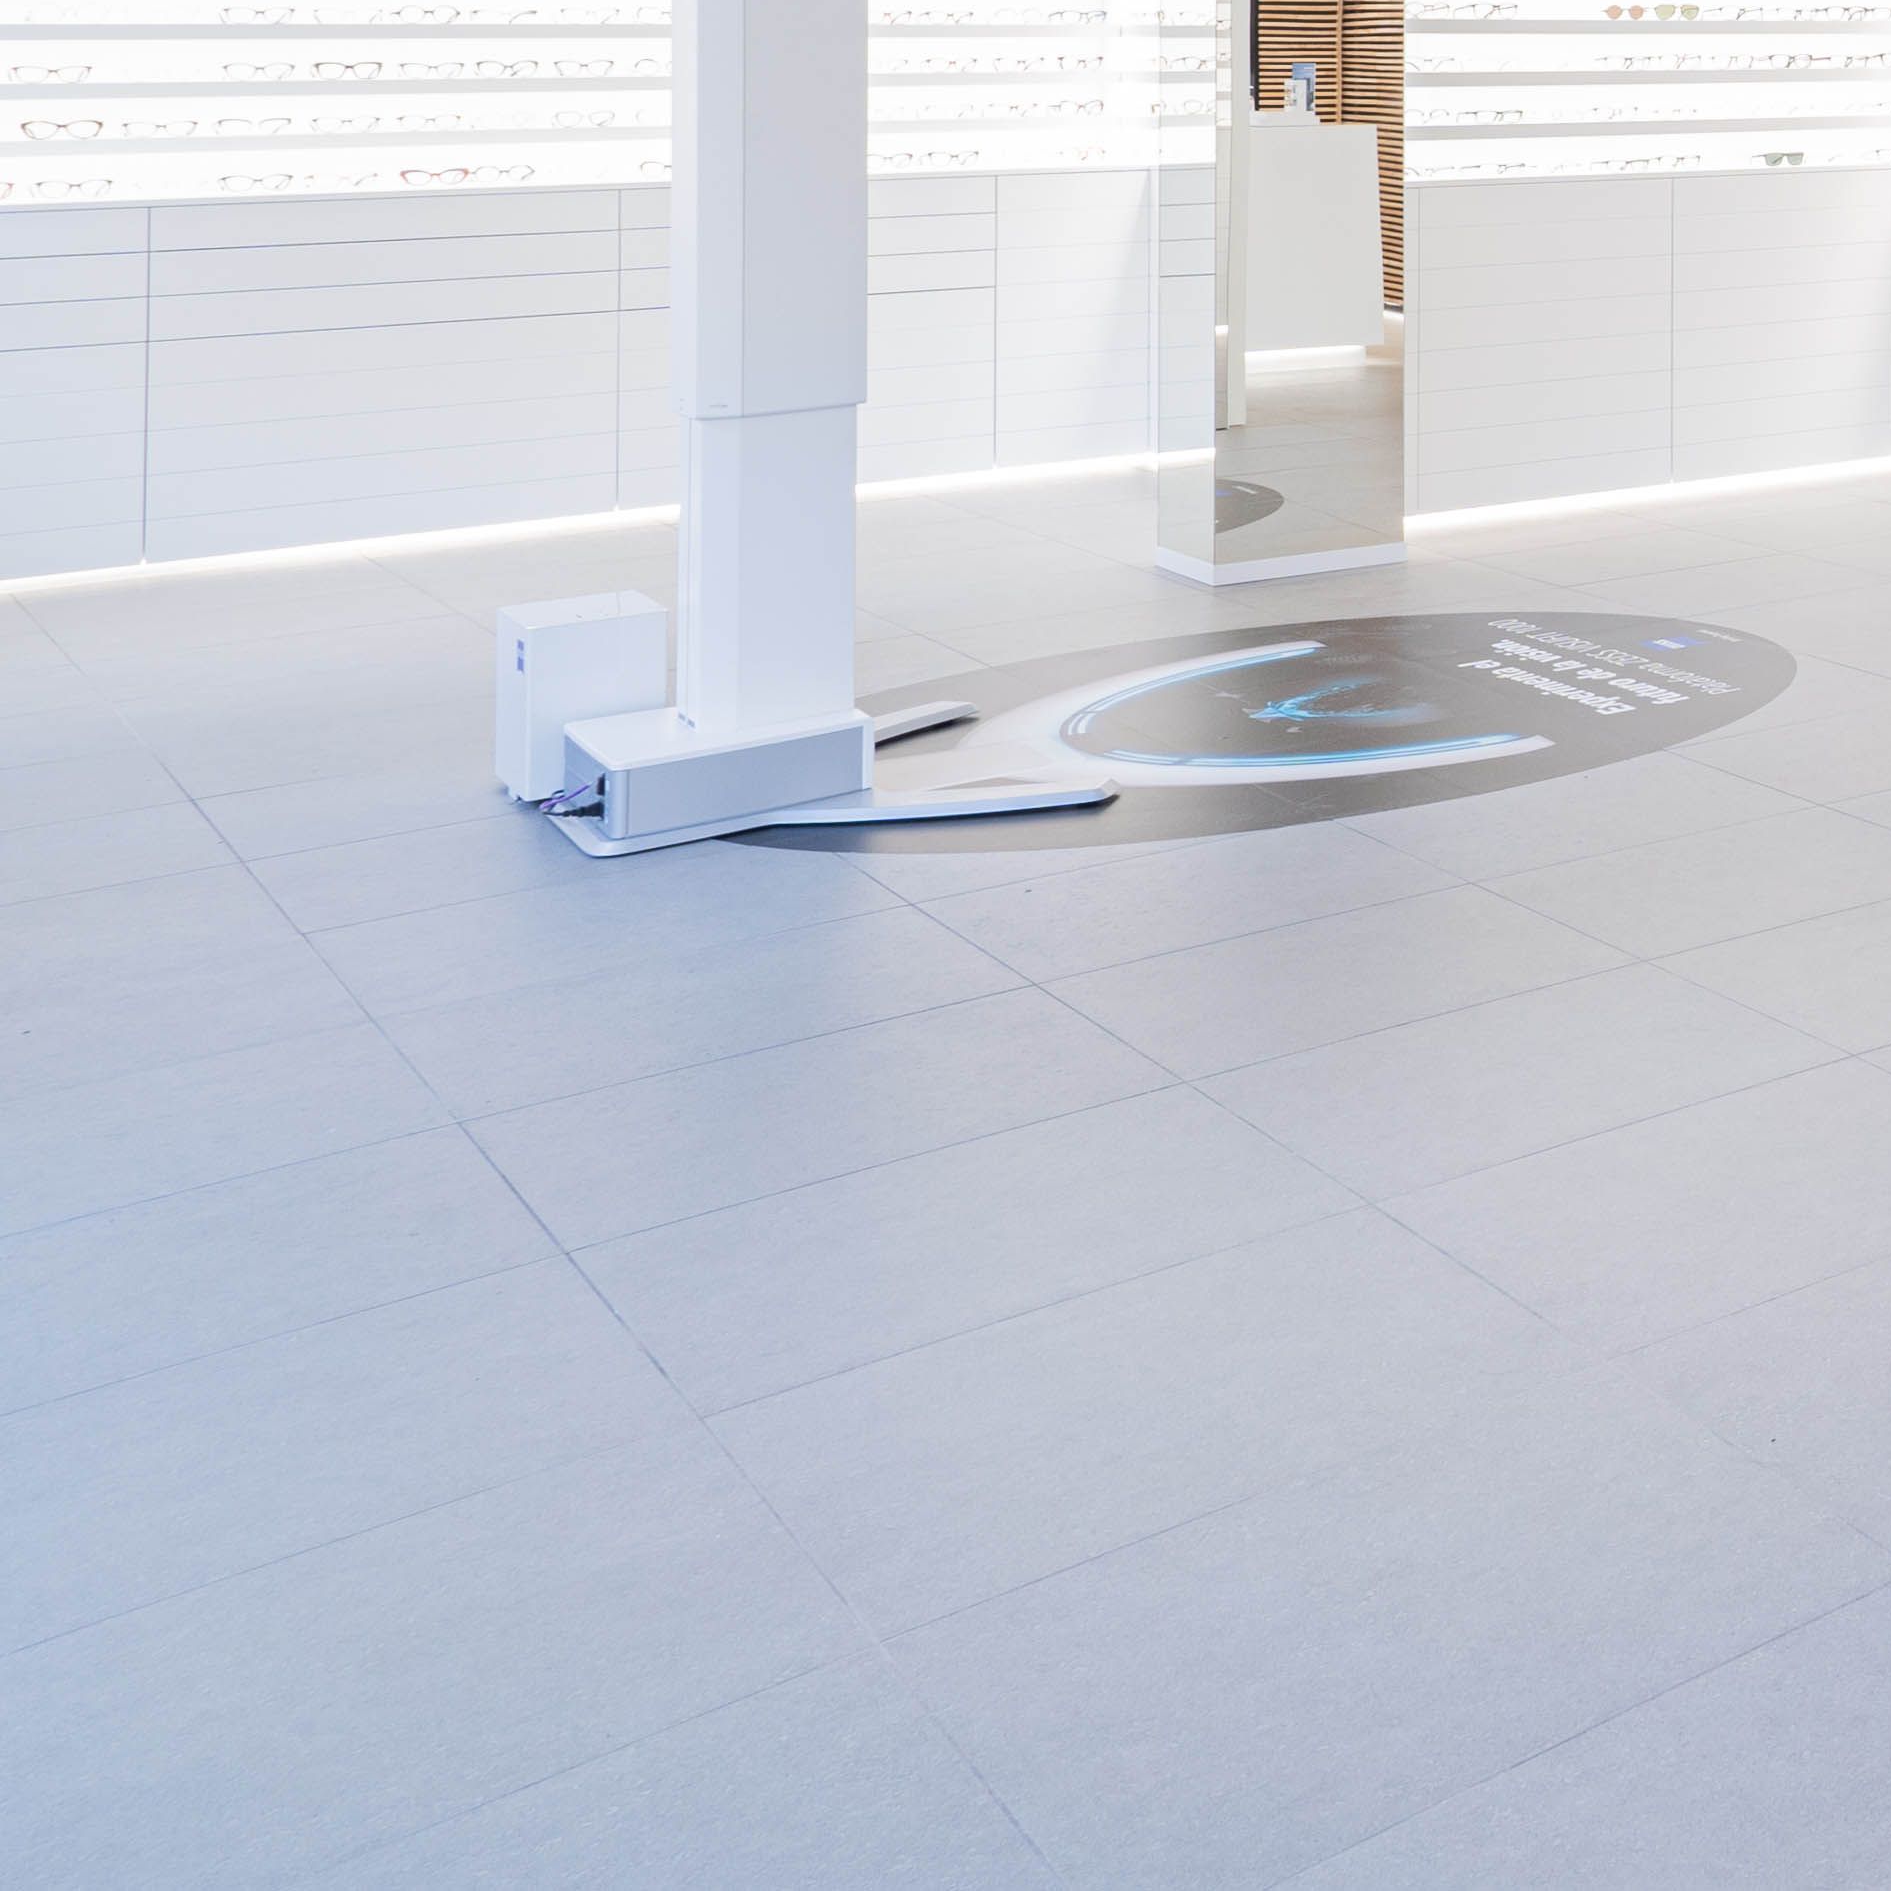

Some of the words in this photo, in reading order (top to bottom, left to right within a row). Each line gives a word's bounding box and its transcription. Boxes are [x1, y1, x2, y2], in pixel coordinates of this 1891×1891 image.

[1457, 658, 1501, 670] el
[1552, 659, 1587, 672] la
[1576, 667, 1617, 680] de
[1638, 661, 1742, 696] Plataforma
[1491, 665, 1637, 715] Experimenta
[1607, 677, 1690, 705] futuro
